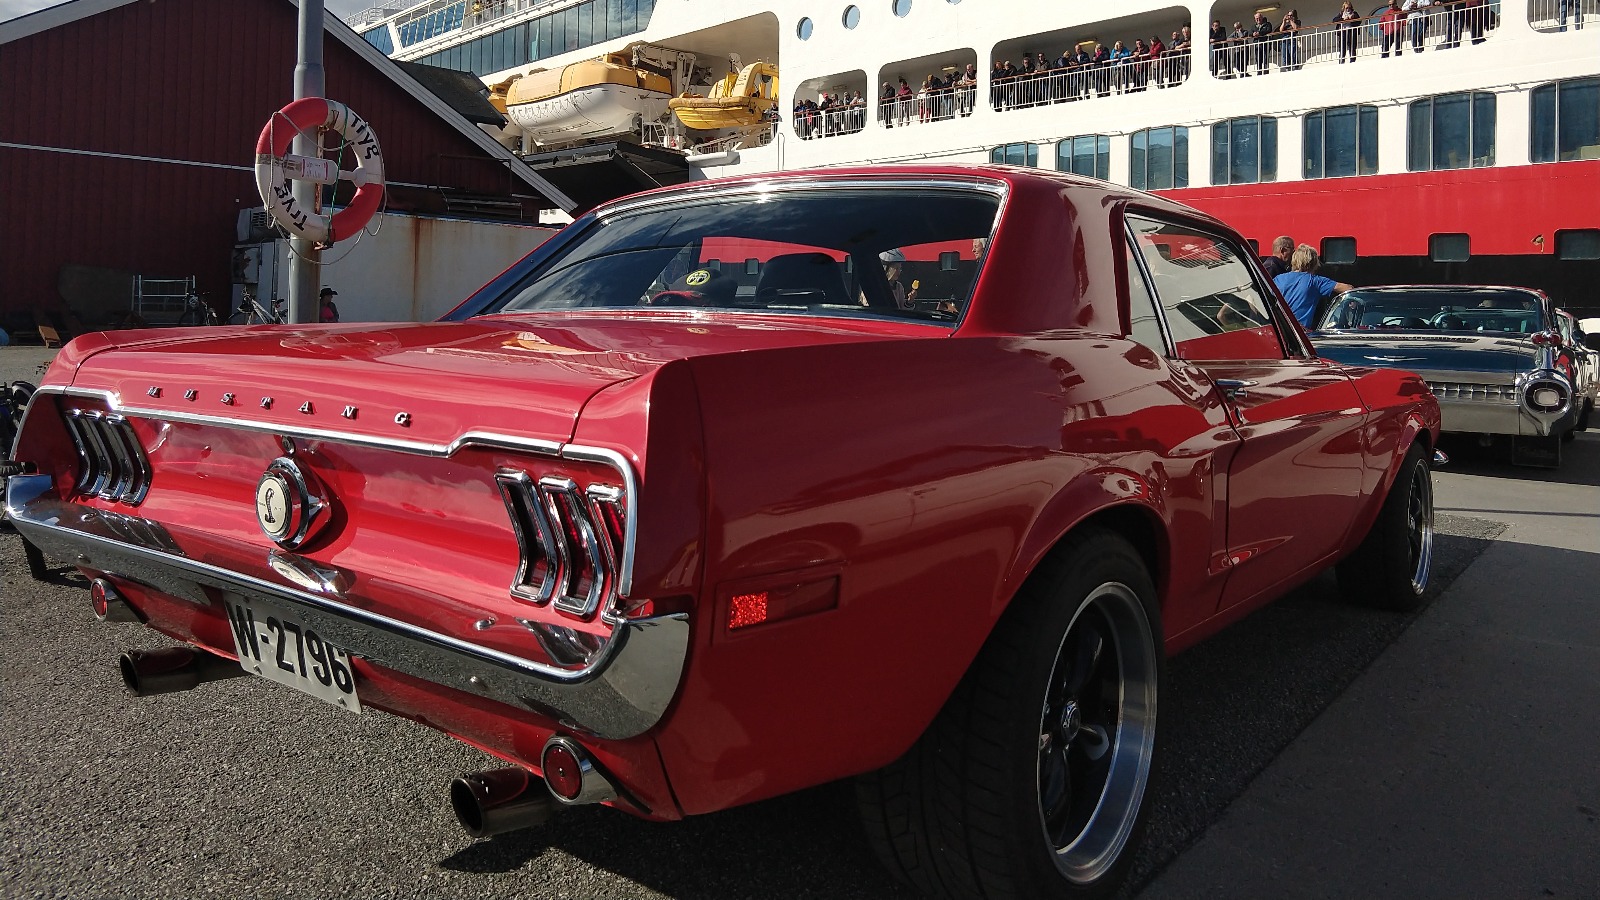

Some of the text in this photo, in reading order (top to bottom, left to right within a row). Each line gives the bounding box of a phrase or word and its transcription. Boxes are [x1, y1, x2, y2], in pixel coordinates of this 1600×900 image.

[350, 112, 380, 160] Tryg
[274, 183, 308, 231] Tryg
[146, 386, 412, 428] MUSTANG
[225, 600, 354, 695] W-2796
